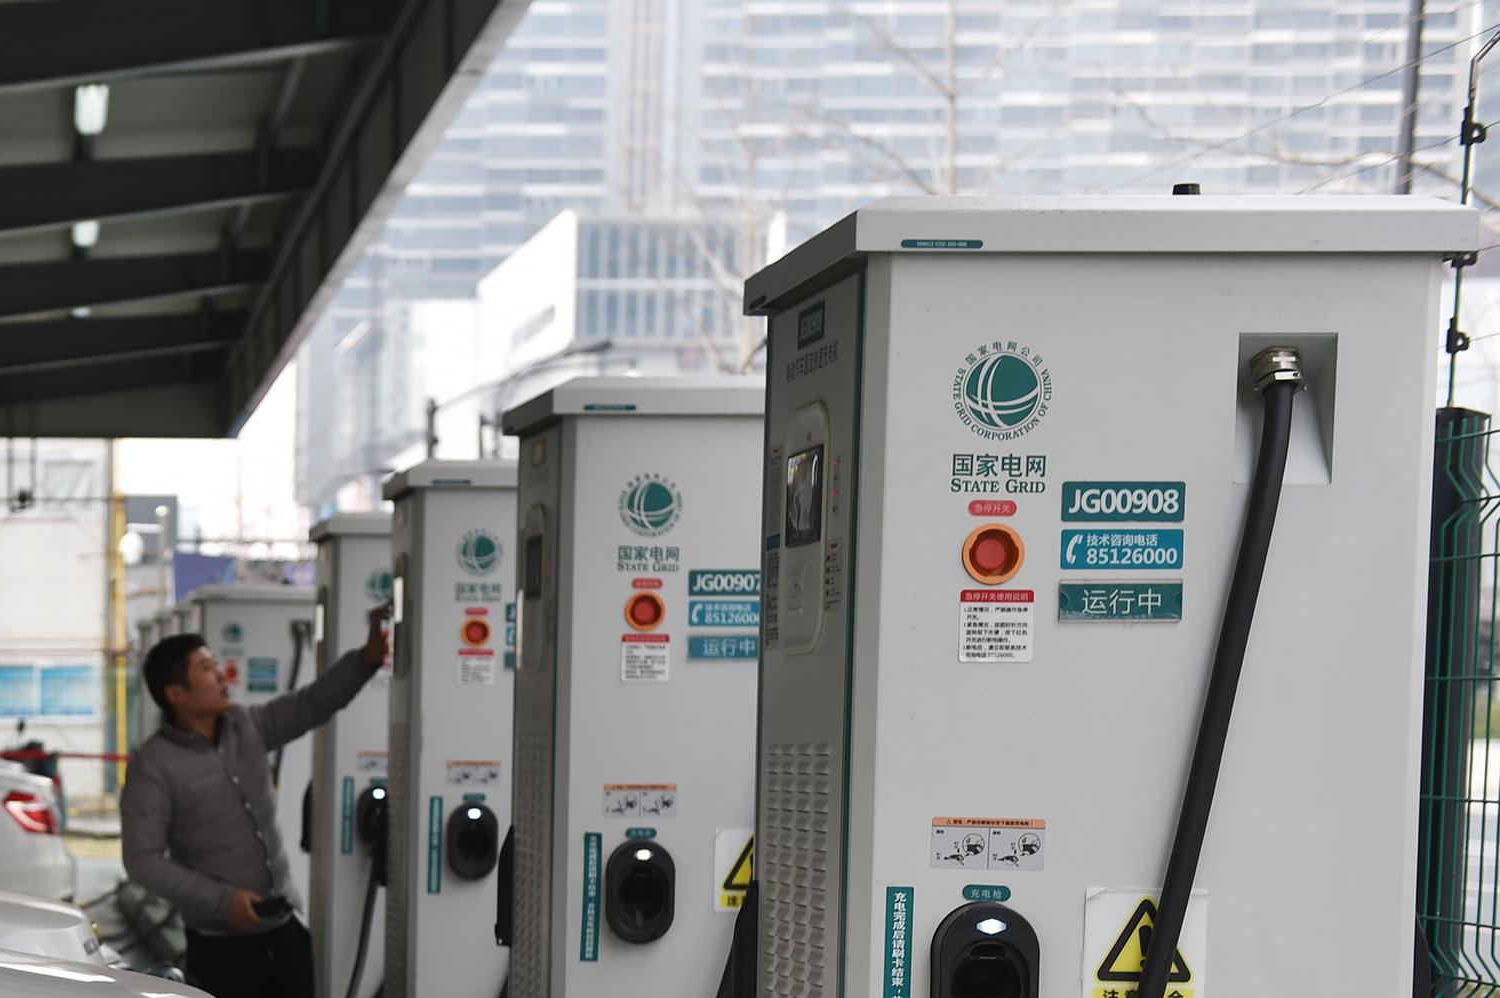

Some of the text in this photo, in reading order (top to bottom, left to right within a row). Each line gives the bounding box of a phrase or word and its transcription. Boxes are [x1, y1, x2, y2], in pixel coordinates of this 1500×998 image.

[965, 341, 1044, 366] 国家电网公司
[953, 368, 1052, 441] STATE GRID CORPORATION OF CHINA
[952, 453, 1047, 478] 国家电网
[950, 478, 1046, 494] STATE GRID
[975, 502, 1012, 514] 急停开关
[1068, 488, 1180, 514] JG00908
[1086, 533, 1158, 547] 技术咨询电话
[1086, 547, 1178, 564] 85126000
[965, 592, 1029, 601] 急停开关使用说明
[1082, 588, 1161, 615] 运行中
[970, 888, 1002, 899] 充电枪
